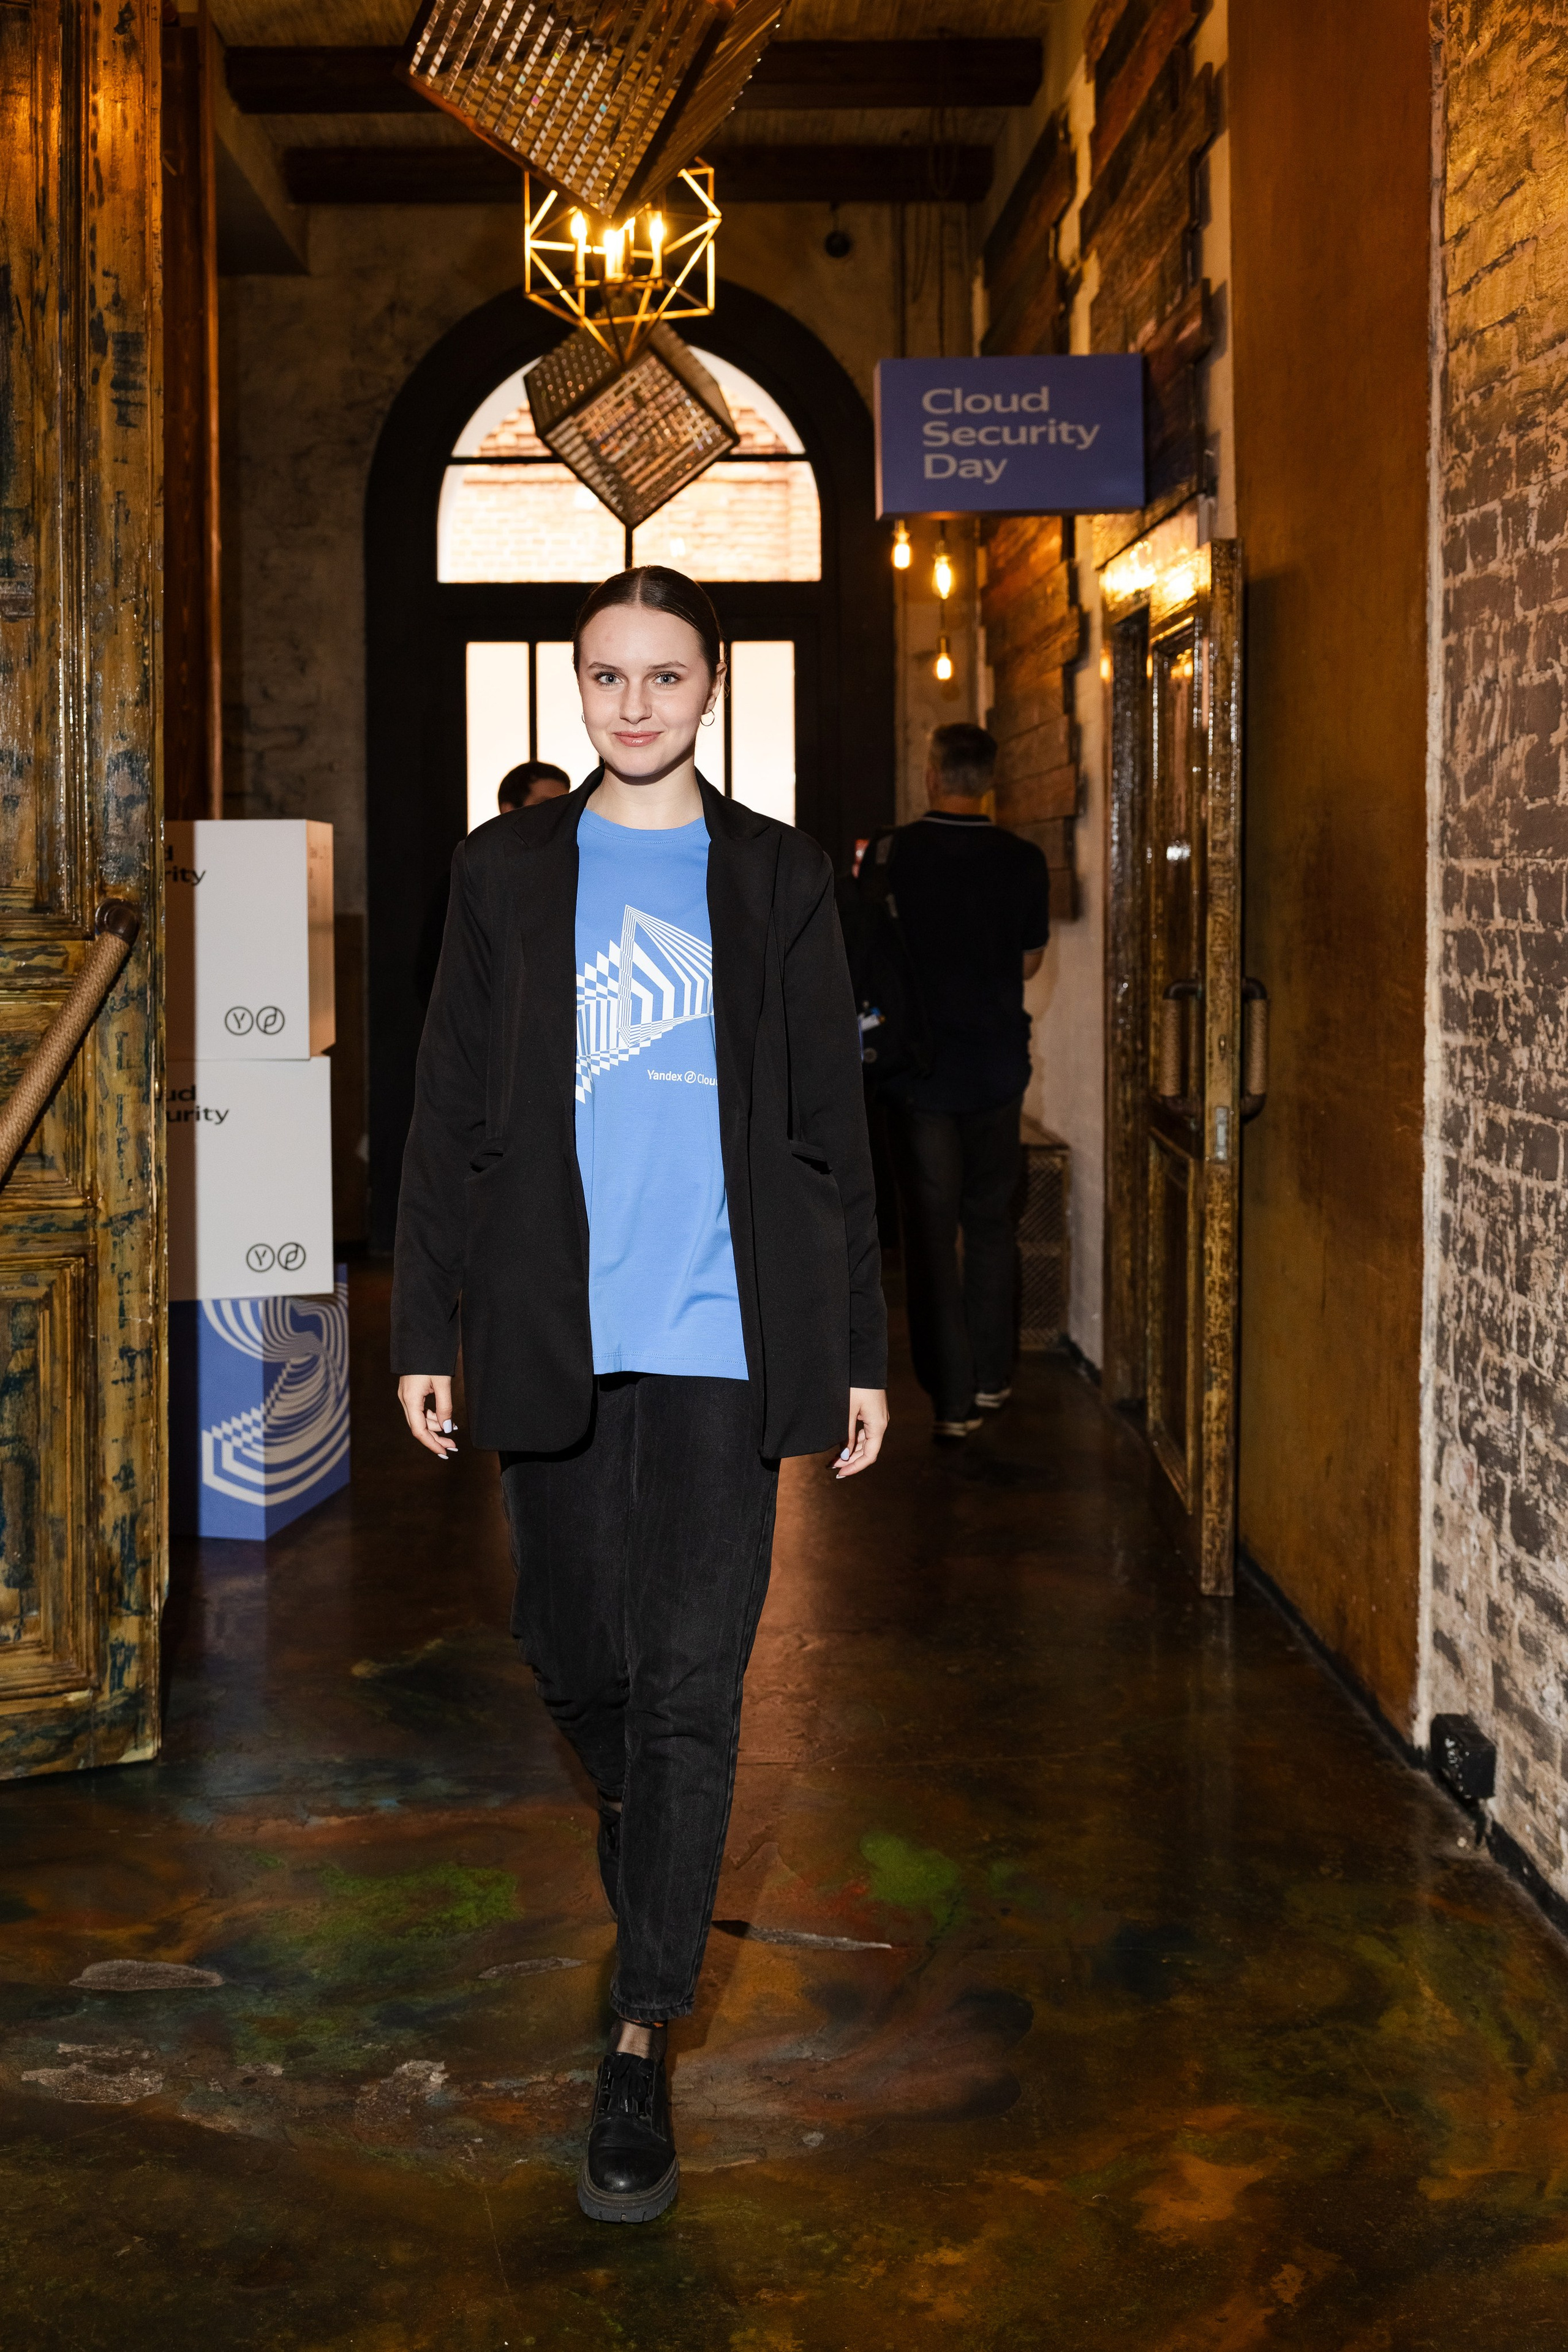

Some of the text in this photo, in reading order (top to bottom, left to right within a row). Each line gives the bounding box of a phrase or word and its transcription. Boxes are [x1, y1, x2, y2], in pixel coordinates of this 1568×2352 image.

[922, 386, 1050, 414] Cloud
[922, 418, 1100, 450] Security
[924, 453, 1008, 484] Day
[165, 865, 206, 886] rity
[647, 1069, 718, 1086] Yandex Clou
[165, 1105, 230, 1125] urity
